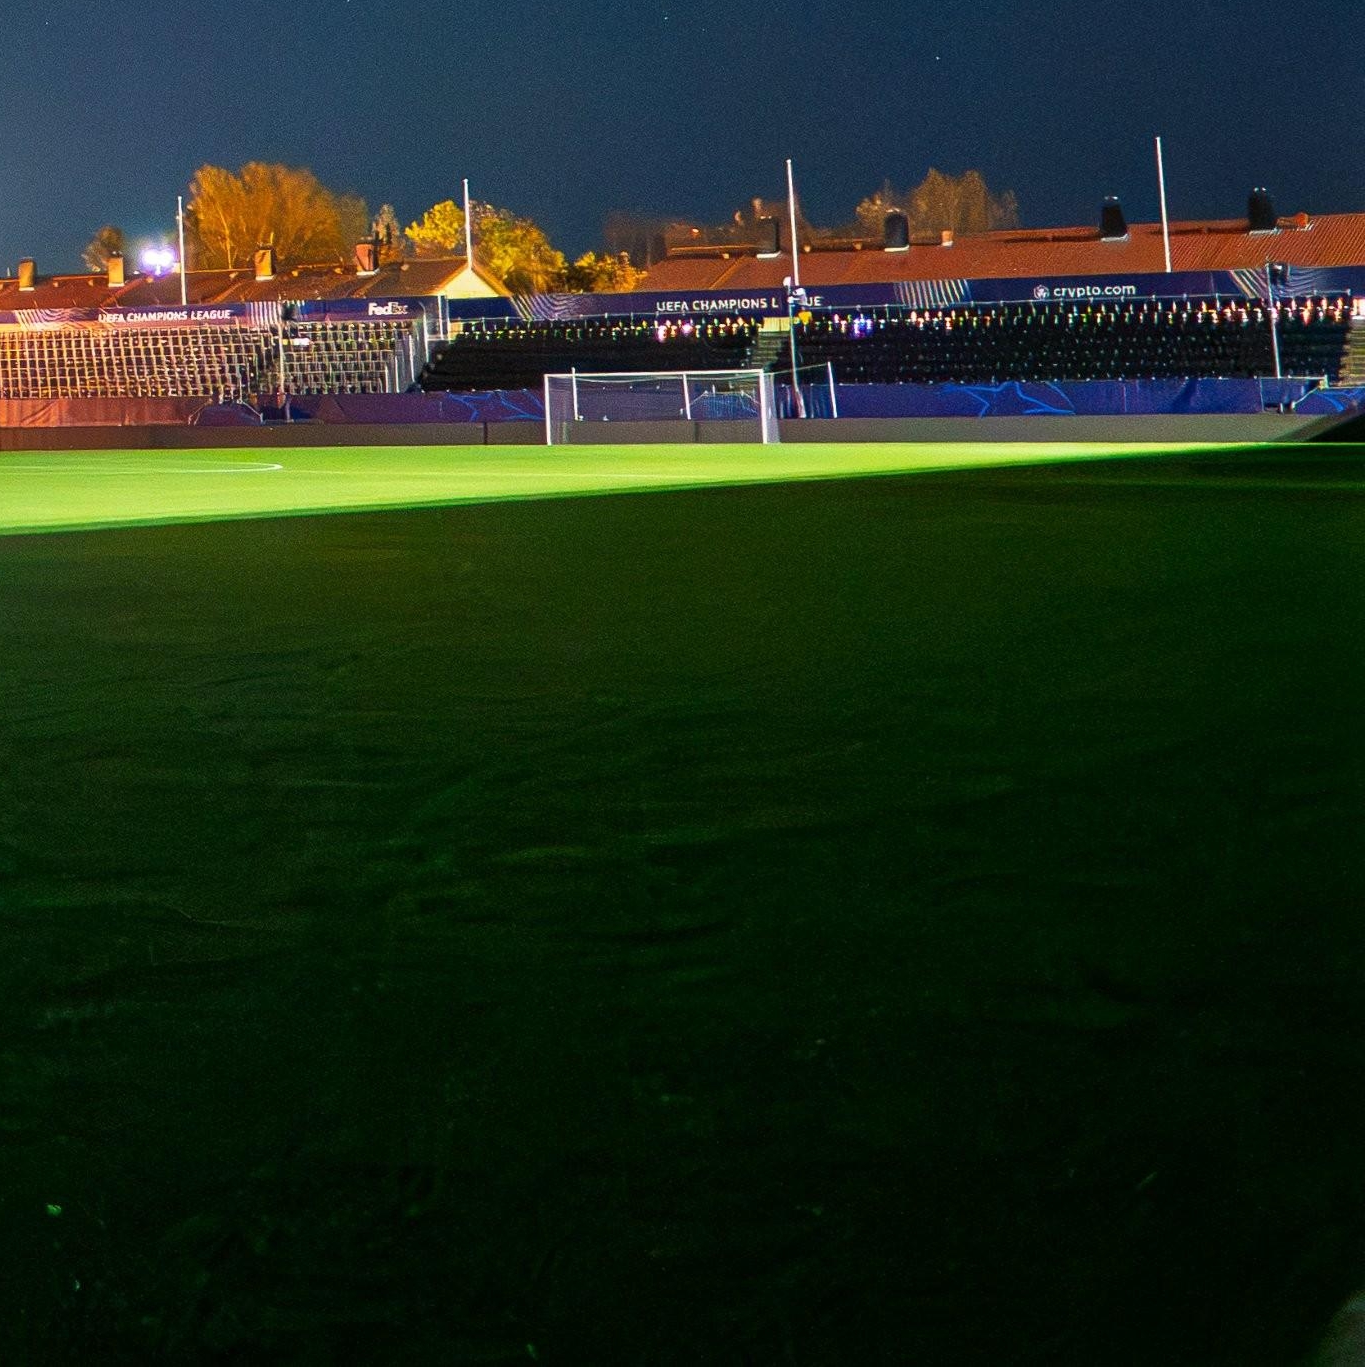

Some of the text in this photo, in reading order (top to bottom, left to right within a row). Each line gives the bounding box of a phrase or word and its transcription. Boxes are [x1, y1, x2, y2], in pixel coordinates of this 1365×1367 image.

[1053, 285, 1137, 298] crypto.com
[368, 301, 409, 316] FedEx
[656, 296, 822, 312] UEFA CHAMPIONS LUE
[98, 309, 232, 323] UEFA CHAMPIONS LEAGUE
